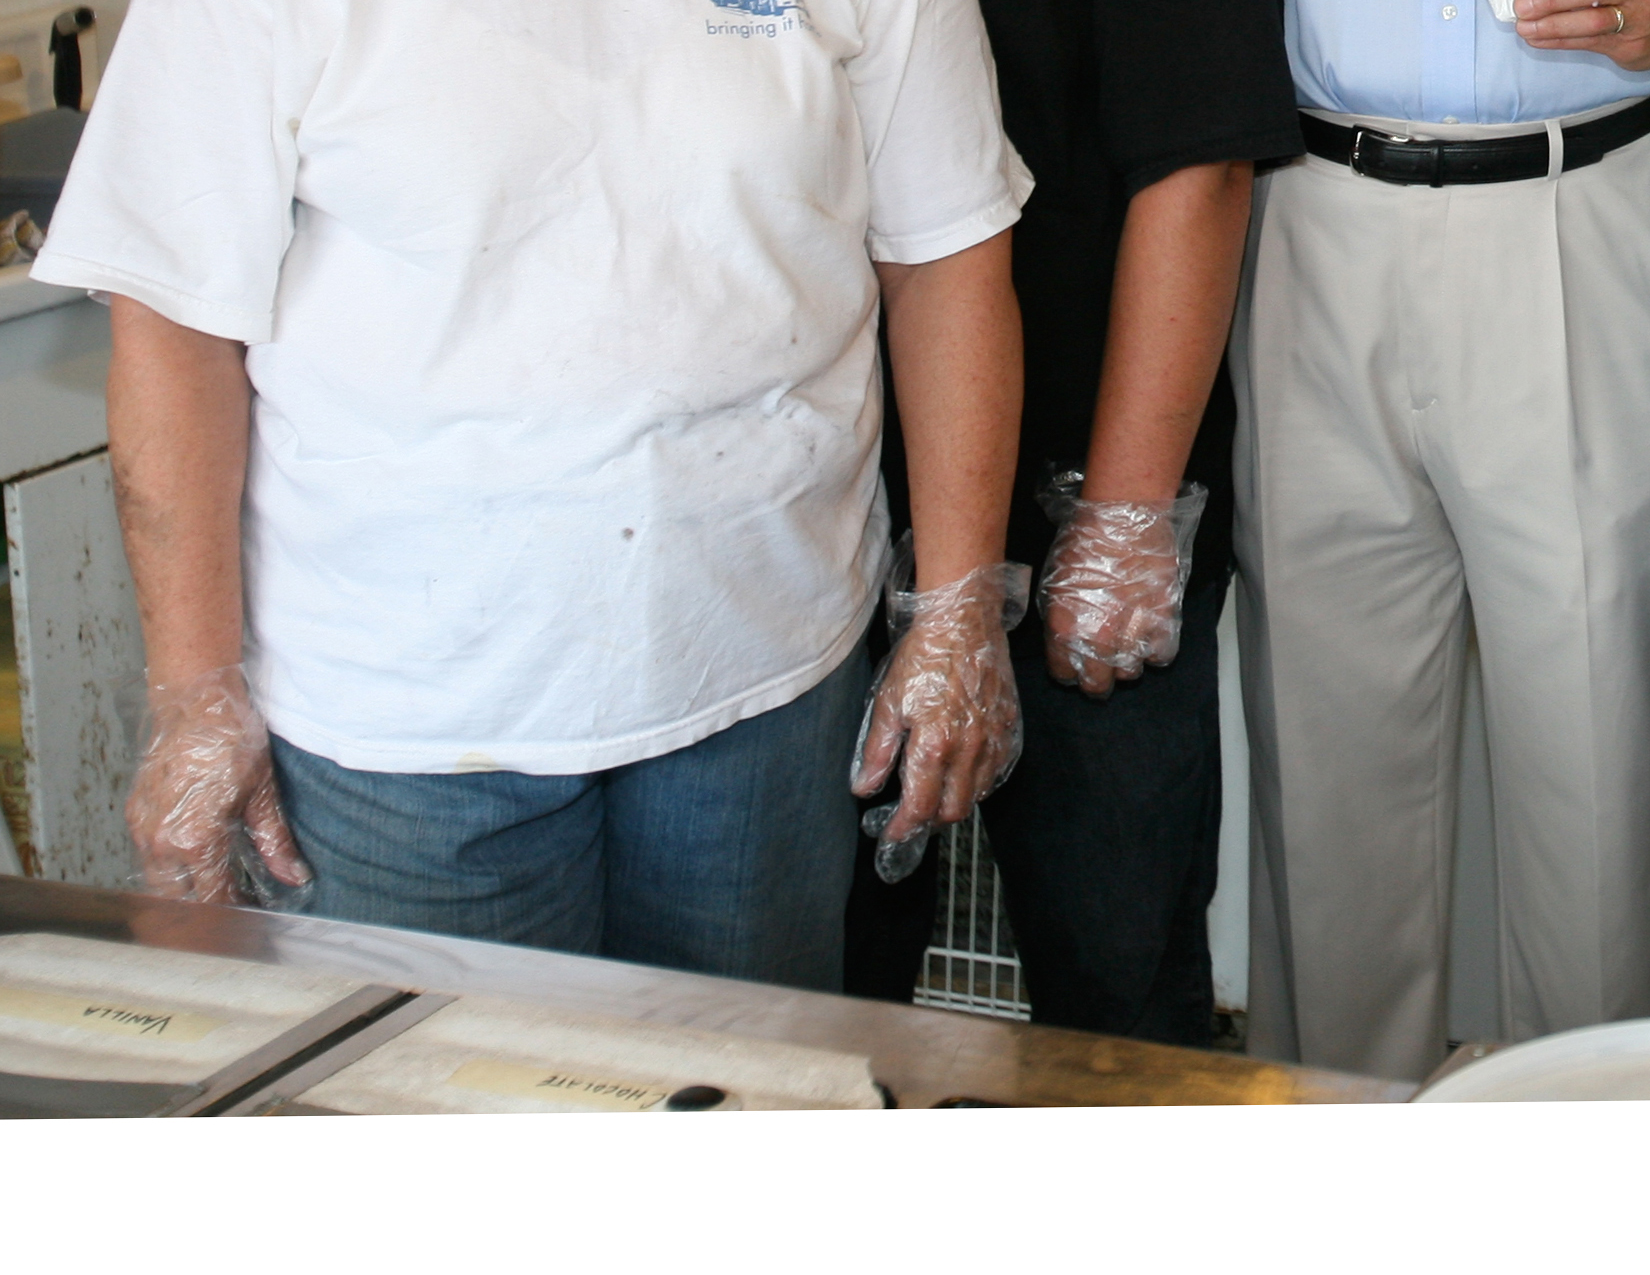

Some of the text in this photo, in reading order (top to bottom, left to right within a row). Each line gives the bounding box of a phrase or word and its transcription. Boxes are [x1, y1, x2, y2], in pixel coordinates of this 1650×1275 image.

[705, 18, 777, 39] bringing
[782, 16, 796, 31] it
[83, 1006, 174, 1035] VANILLA
[535, 1075, 667, 1111] CHOCOLATE
